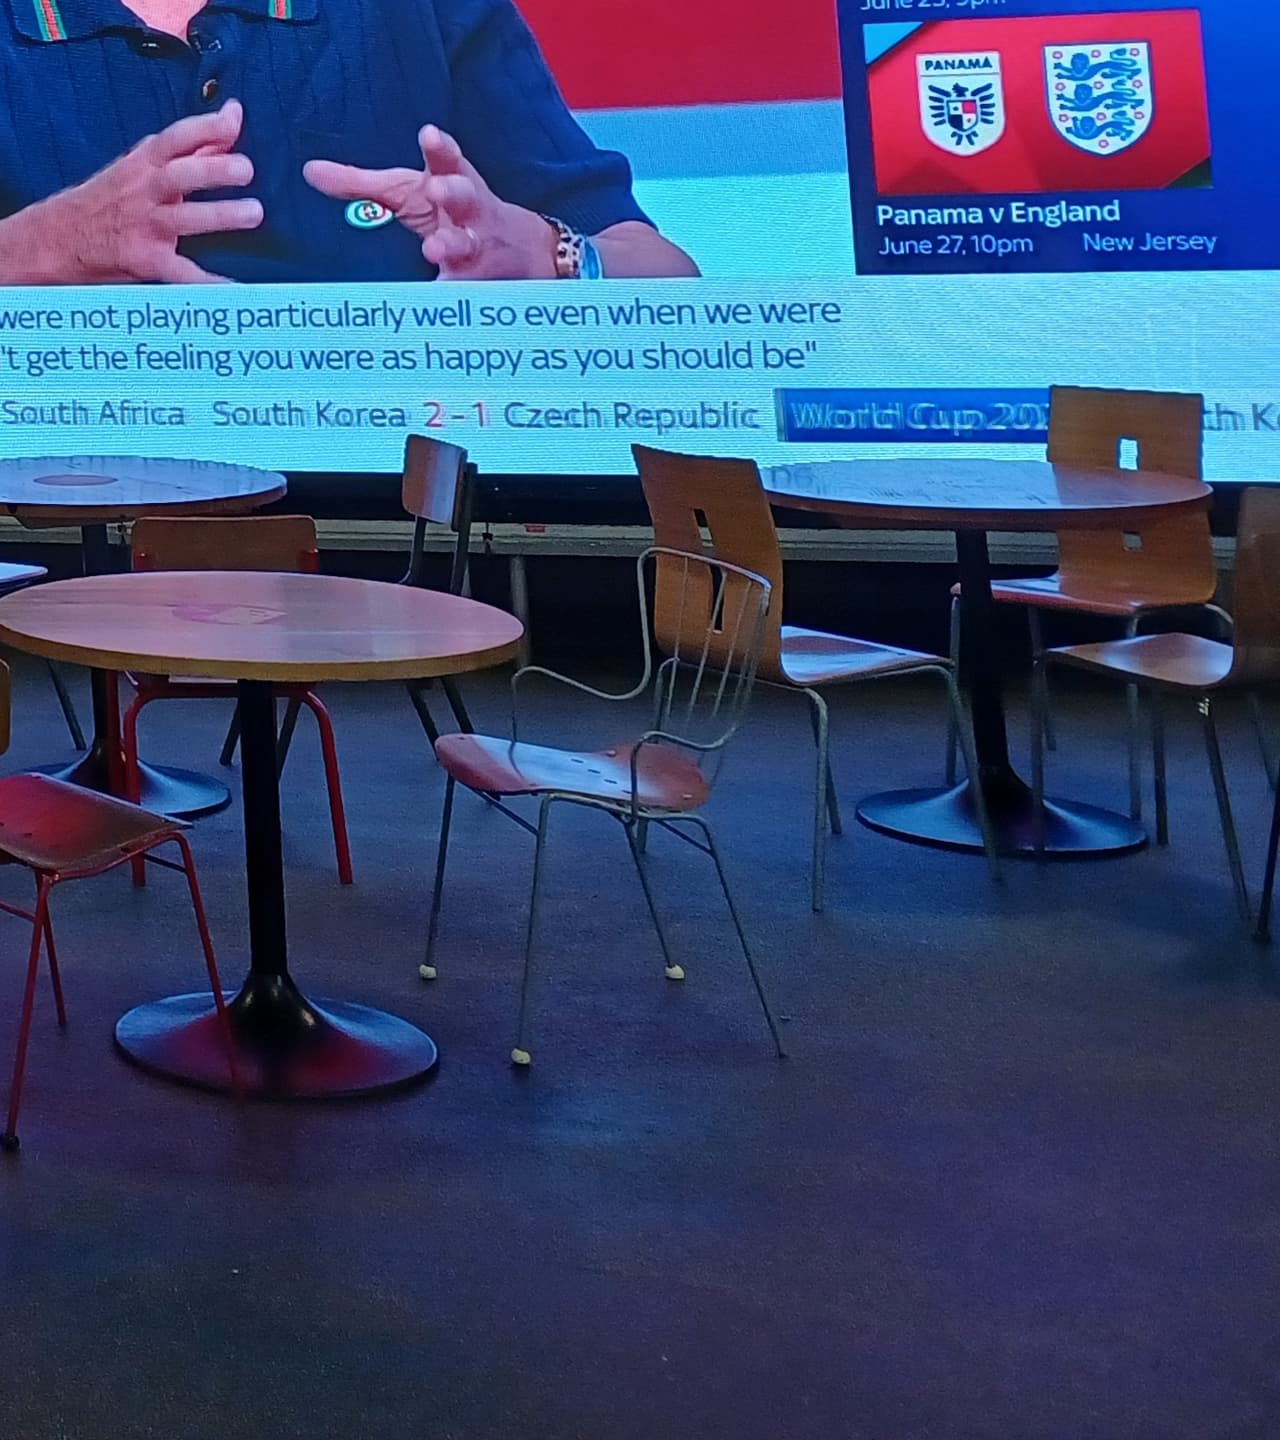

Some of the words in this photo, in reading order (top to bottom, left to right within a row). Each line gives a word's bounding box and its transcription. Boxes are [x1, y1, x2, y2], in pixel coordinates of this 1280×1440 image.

[876, 205, 983, 227] Panama
[989, 207, 1004, 223] v
[1010, 200, 1121, 228] England
[878, 236, 933, 256] June
[936, 235, 968, 256] 27,
[971, 234, 1034, 257] 10pm
[1083, 232, 1134, 252] New
[1139, 232, 1218, 254] Jersey
[71, 305, 120, 329] not
[127, 303, 231, 335] playing
[237, 300, 407, 334] particularly
[414, 299, 472, 327] well
[480, 305, 516, 326] so
[524, 304, 599, 326] even
[607, 297, 696, 325] when
[704, 302, 752, 324] we
[758, 300, 841, 323] were
[27, 348, 74, 376] get
[78, 343, 129, 370] the
[134, 342, 233, 376] feeling
[238, 349, 295, 375] you
[300, 347, 374, 370] were
[381, 347, 418, 370] as
[424, 342, 523, 376] happy
[531, 347, 569, 370] as
[574, 347, 635, 376] you
[642, 340, 753, 369] should
[762, 340, 817, 368] be"
[2, 400, 88, 425] South
[99, 400, 185, 425] Africa
[213, 401, 305, 427] South
[316, 402, 406, 427] Korea
[504, 401, 602, 428] Czech
[613, 402, 760, 435] Republic
[790, 402, 903, 429] World
[907, 403, 985, 437] Cup
